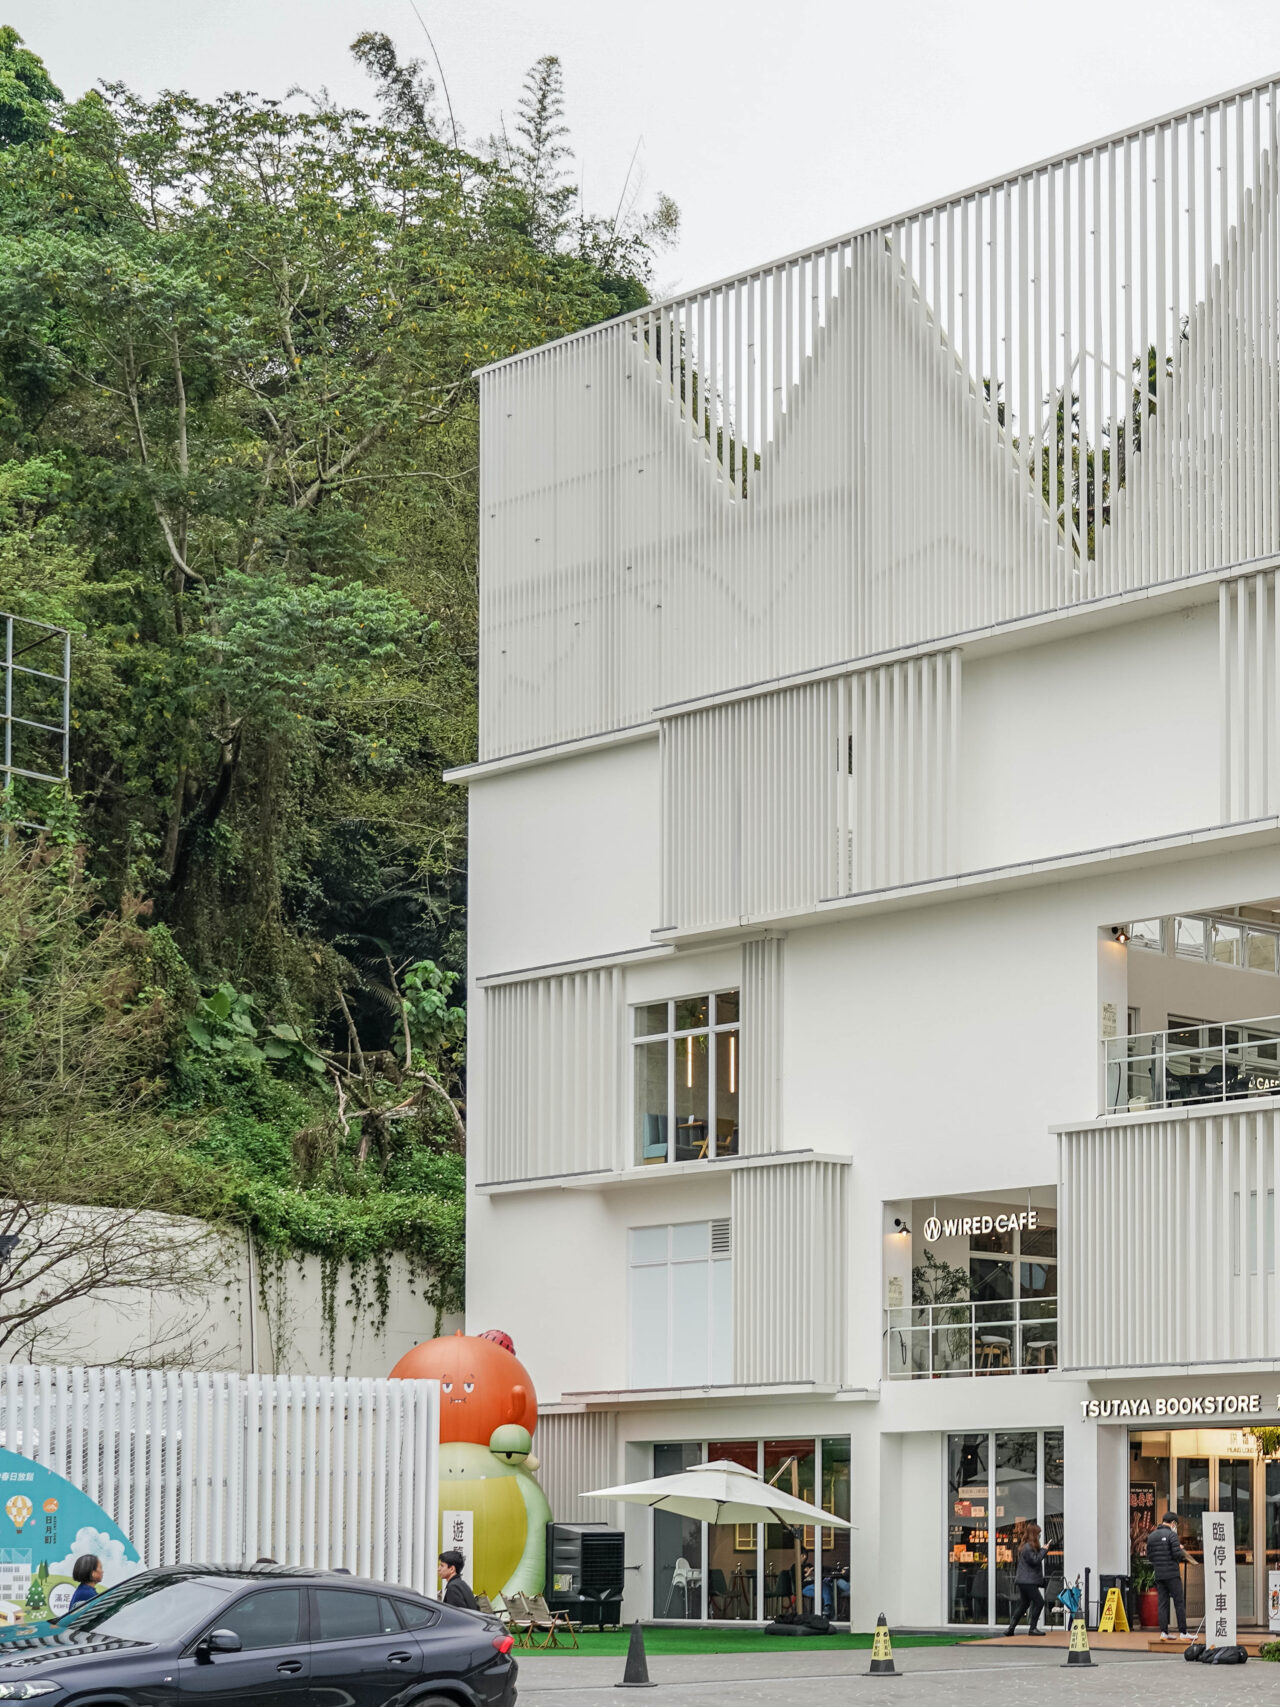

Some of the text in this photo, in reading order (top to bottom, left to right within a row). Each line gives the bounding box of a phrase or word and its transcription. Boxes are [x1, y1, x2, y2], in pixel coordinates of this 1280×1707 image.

[943, 1216, 993, 1237] WIRED
[995, 1211, 1038, 1233] CAFE
[1080, 1395, 1261, 1418] TSUTAYA BOOKSTORE
[0, 1472, 34, 1481] 春日放鬆
[1212, 1521, 1228, 1638] 臨停下車處
[55, 1593, 70, 1601] 滿足
